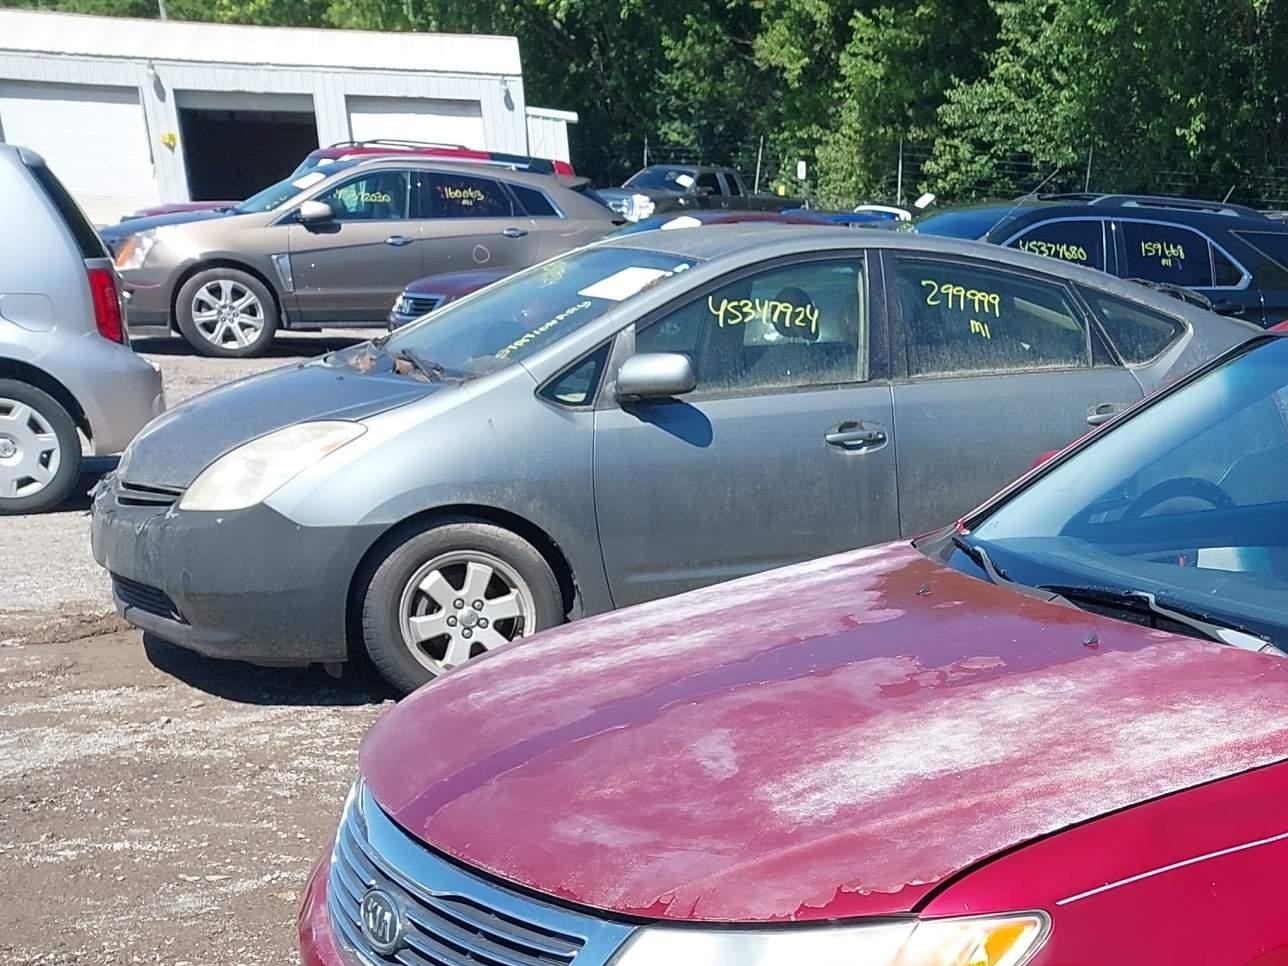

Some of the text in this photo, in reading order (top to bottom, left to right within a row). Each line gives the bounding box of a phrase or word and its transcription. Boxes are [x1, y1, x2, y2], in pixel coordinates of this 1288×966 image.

[1141, 239, 1185, 260] 159668
[708, 295, 819, 333] 45347924
[920, 279, 1000, 318] 299999
